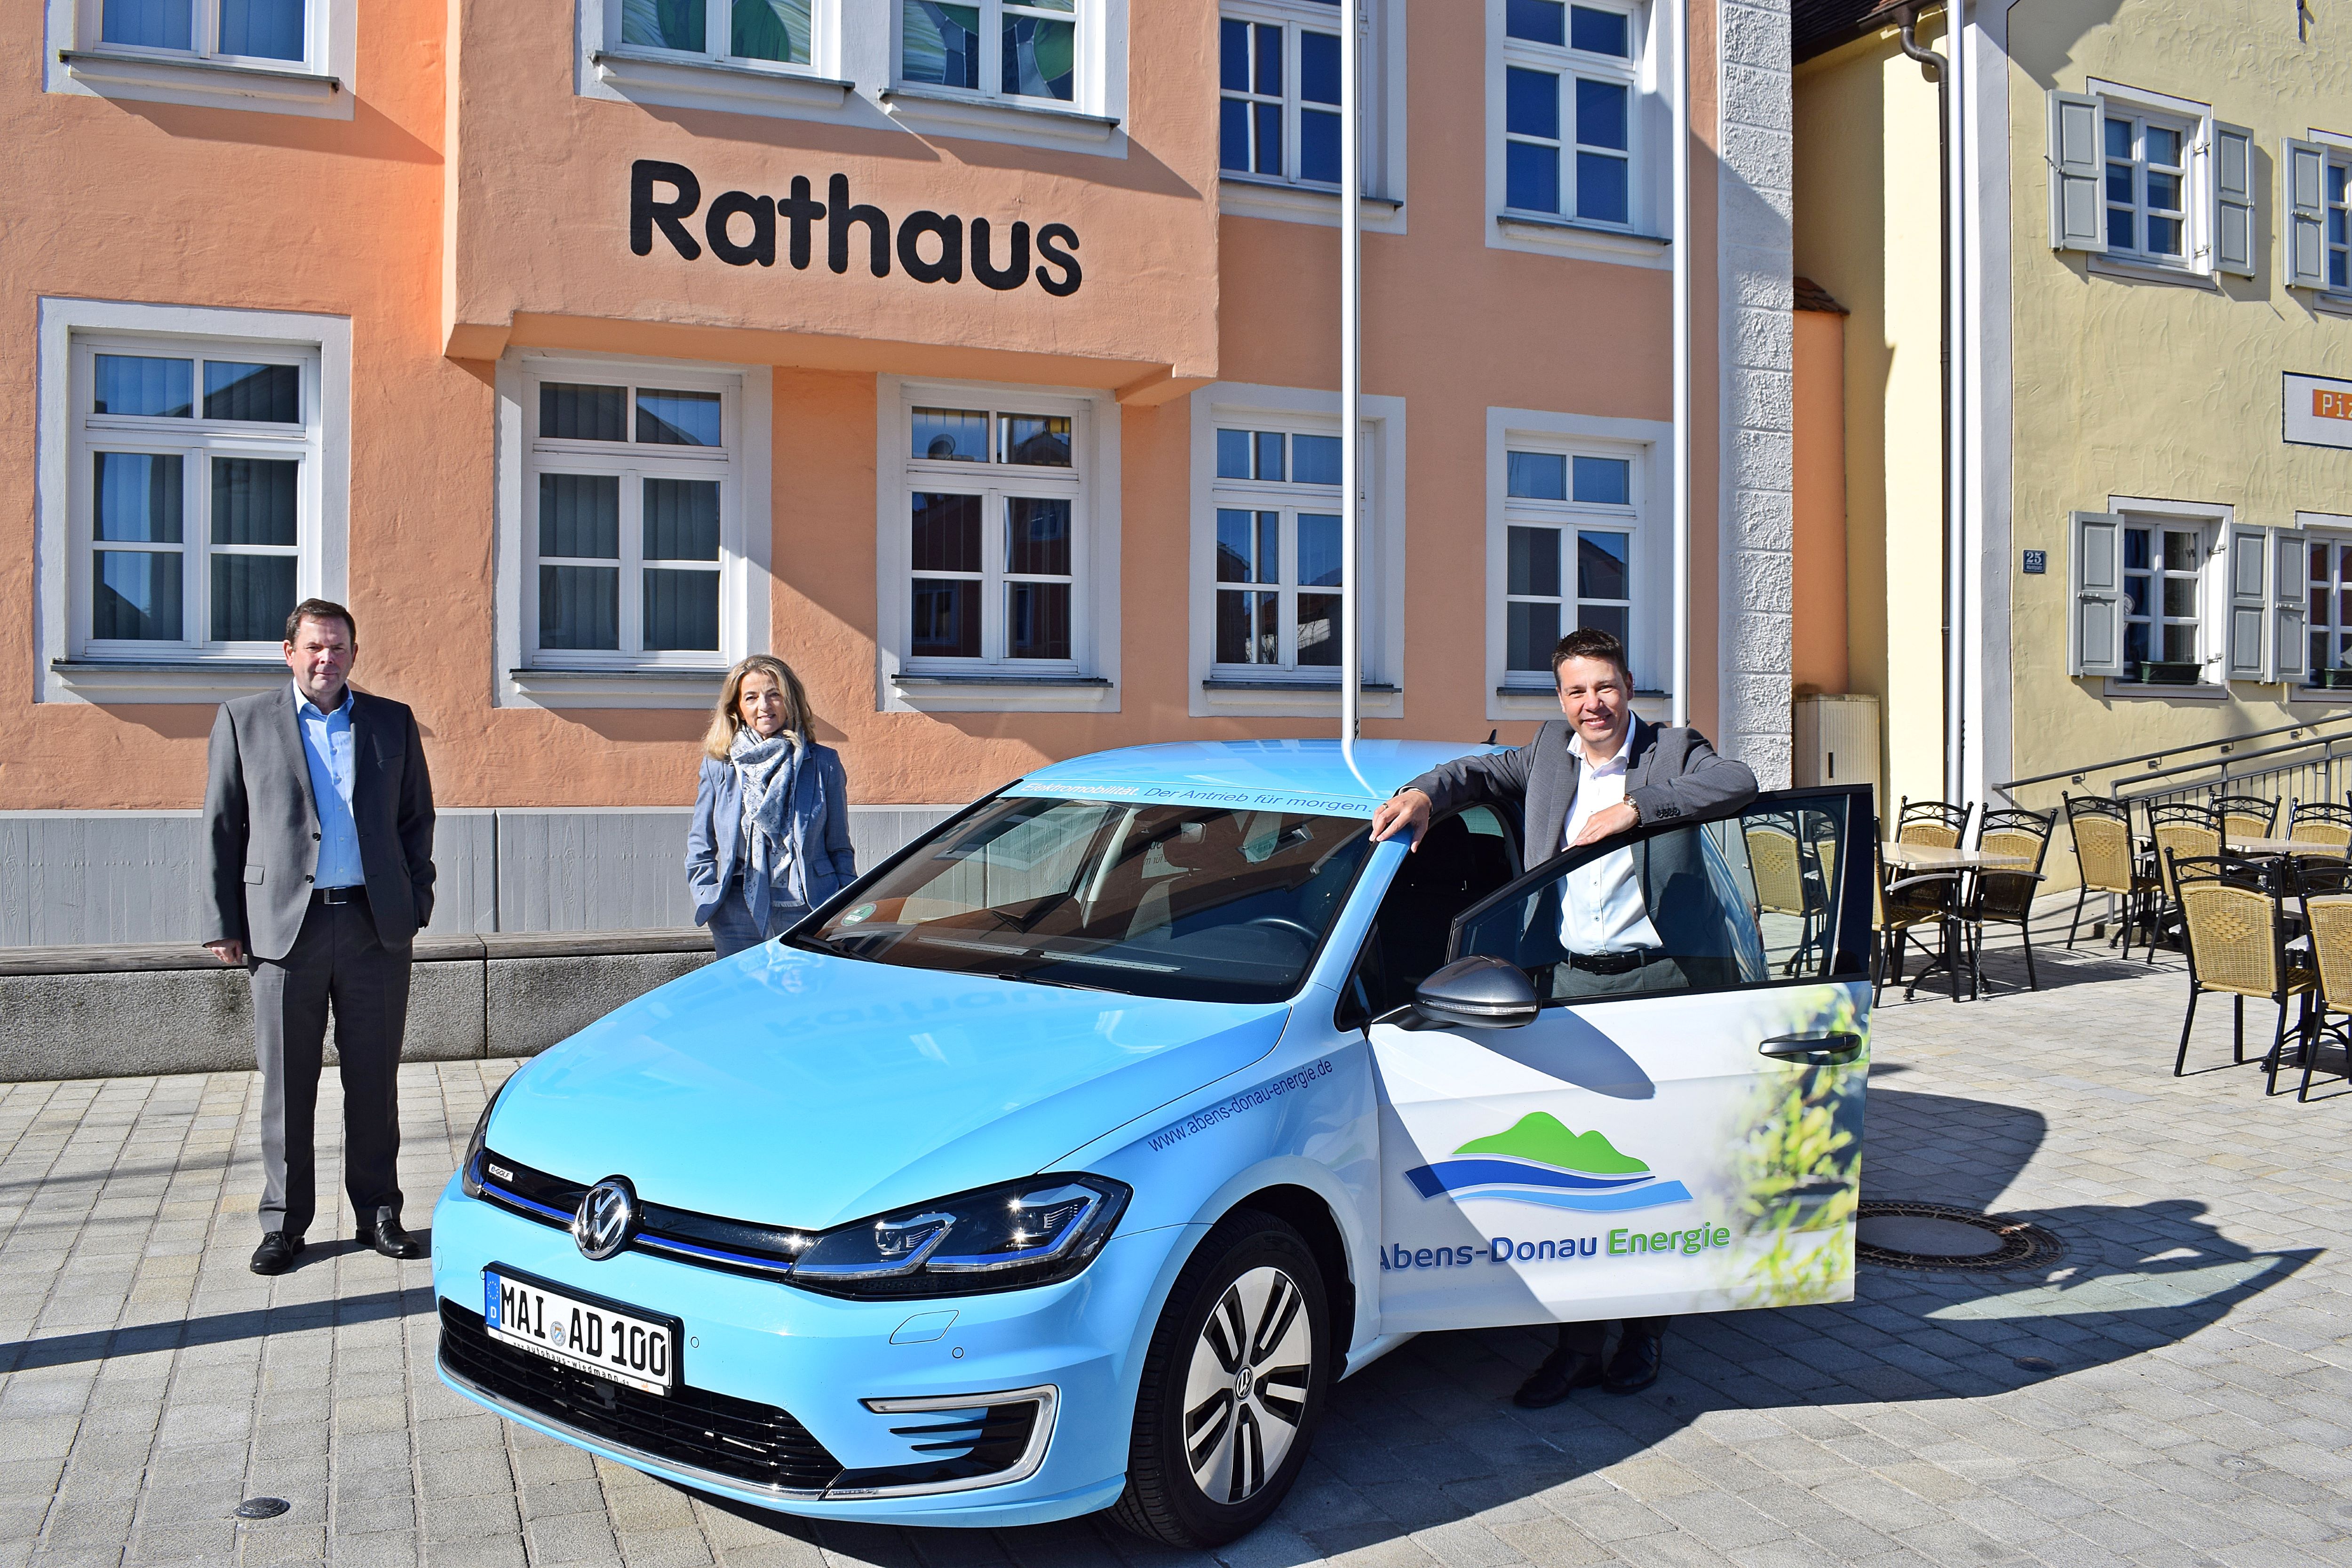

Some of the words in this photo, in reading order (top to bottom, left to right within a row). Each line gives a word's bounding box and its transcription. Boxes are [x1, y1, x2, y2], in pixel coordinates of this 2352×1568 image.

[630, 159, 1082, 297] Rathaus
[2026, 552, 2042, 564] 25
[1020, 783, 1140, 796] Elektromobilität.
[1144, 788, 1179, 797] Der
[1178, 789, 1248, 802] Antrieb
[1253, 794, 1283, 804] für
[1286, 798, 1372, 812] morgen.
[1147, 1059, 1332, 1152] www.abens-donau-energie.de
[1380, 1235, 1597, 1270] Abens-Donau
[1608, 1222, 1731, 1255] Energie
[491, 1306, 497, 1318] D
[501, 1283, 546, 1339] MAI
[569, 1307, 603, 1358] AD
[611, 1321, 666, 1377] 100
[513, 1341, 630, 1386] www.autohaus-wiedmann.de
